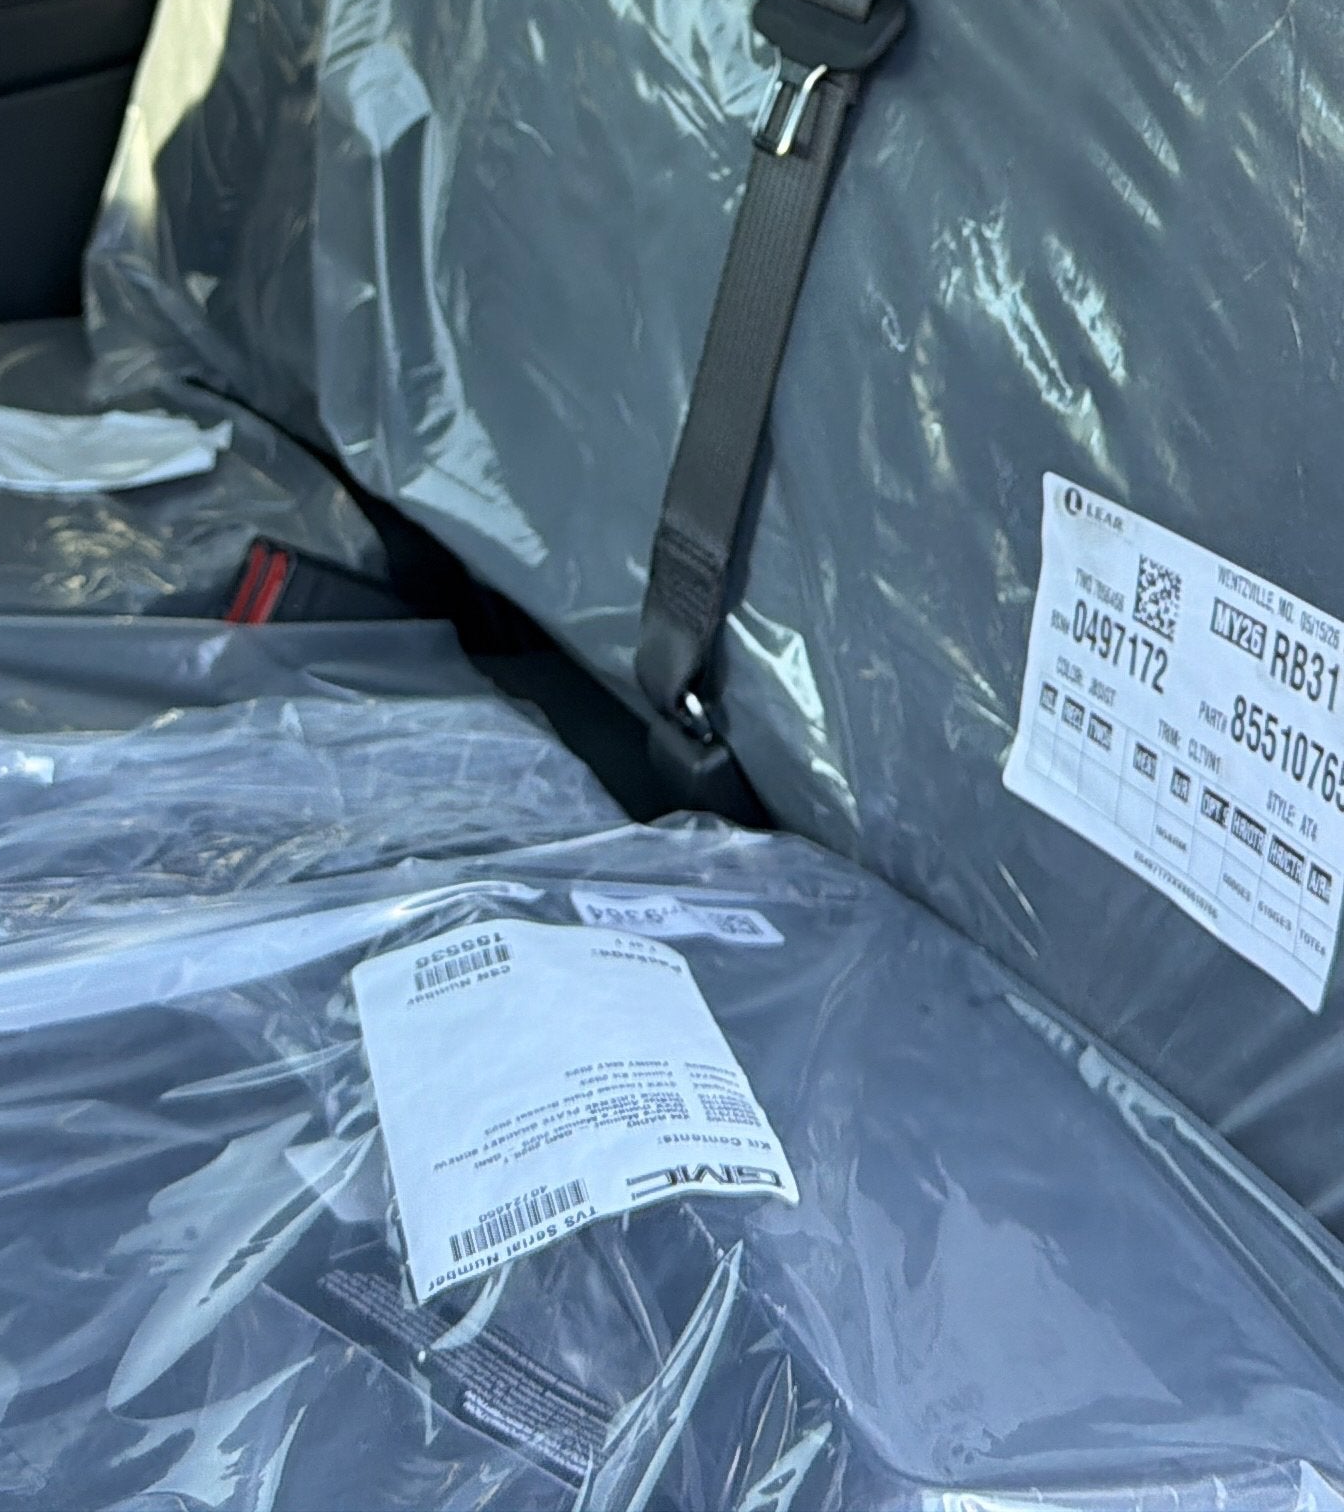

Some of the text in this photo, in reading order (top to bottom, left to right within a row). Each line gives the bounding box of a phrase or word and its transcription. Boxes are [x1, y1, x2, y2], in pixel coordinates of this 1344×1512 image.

[1085, 503, 1125, 533] LEAR
[1072, 598, 1169, 695] 0497172
[1213, 598, 1340, 712] MY26 RB31
[657, 1133, 772, 1151] Kit Contents:
[625, 1162, 786, 1201] GMC
[428, 1204, 598, 1292] TVS Serial Number
